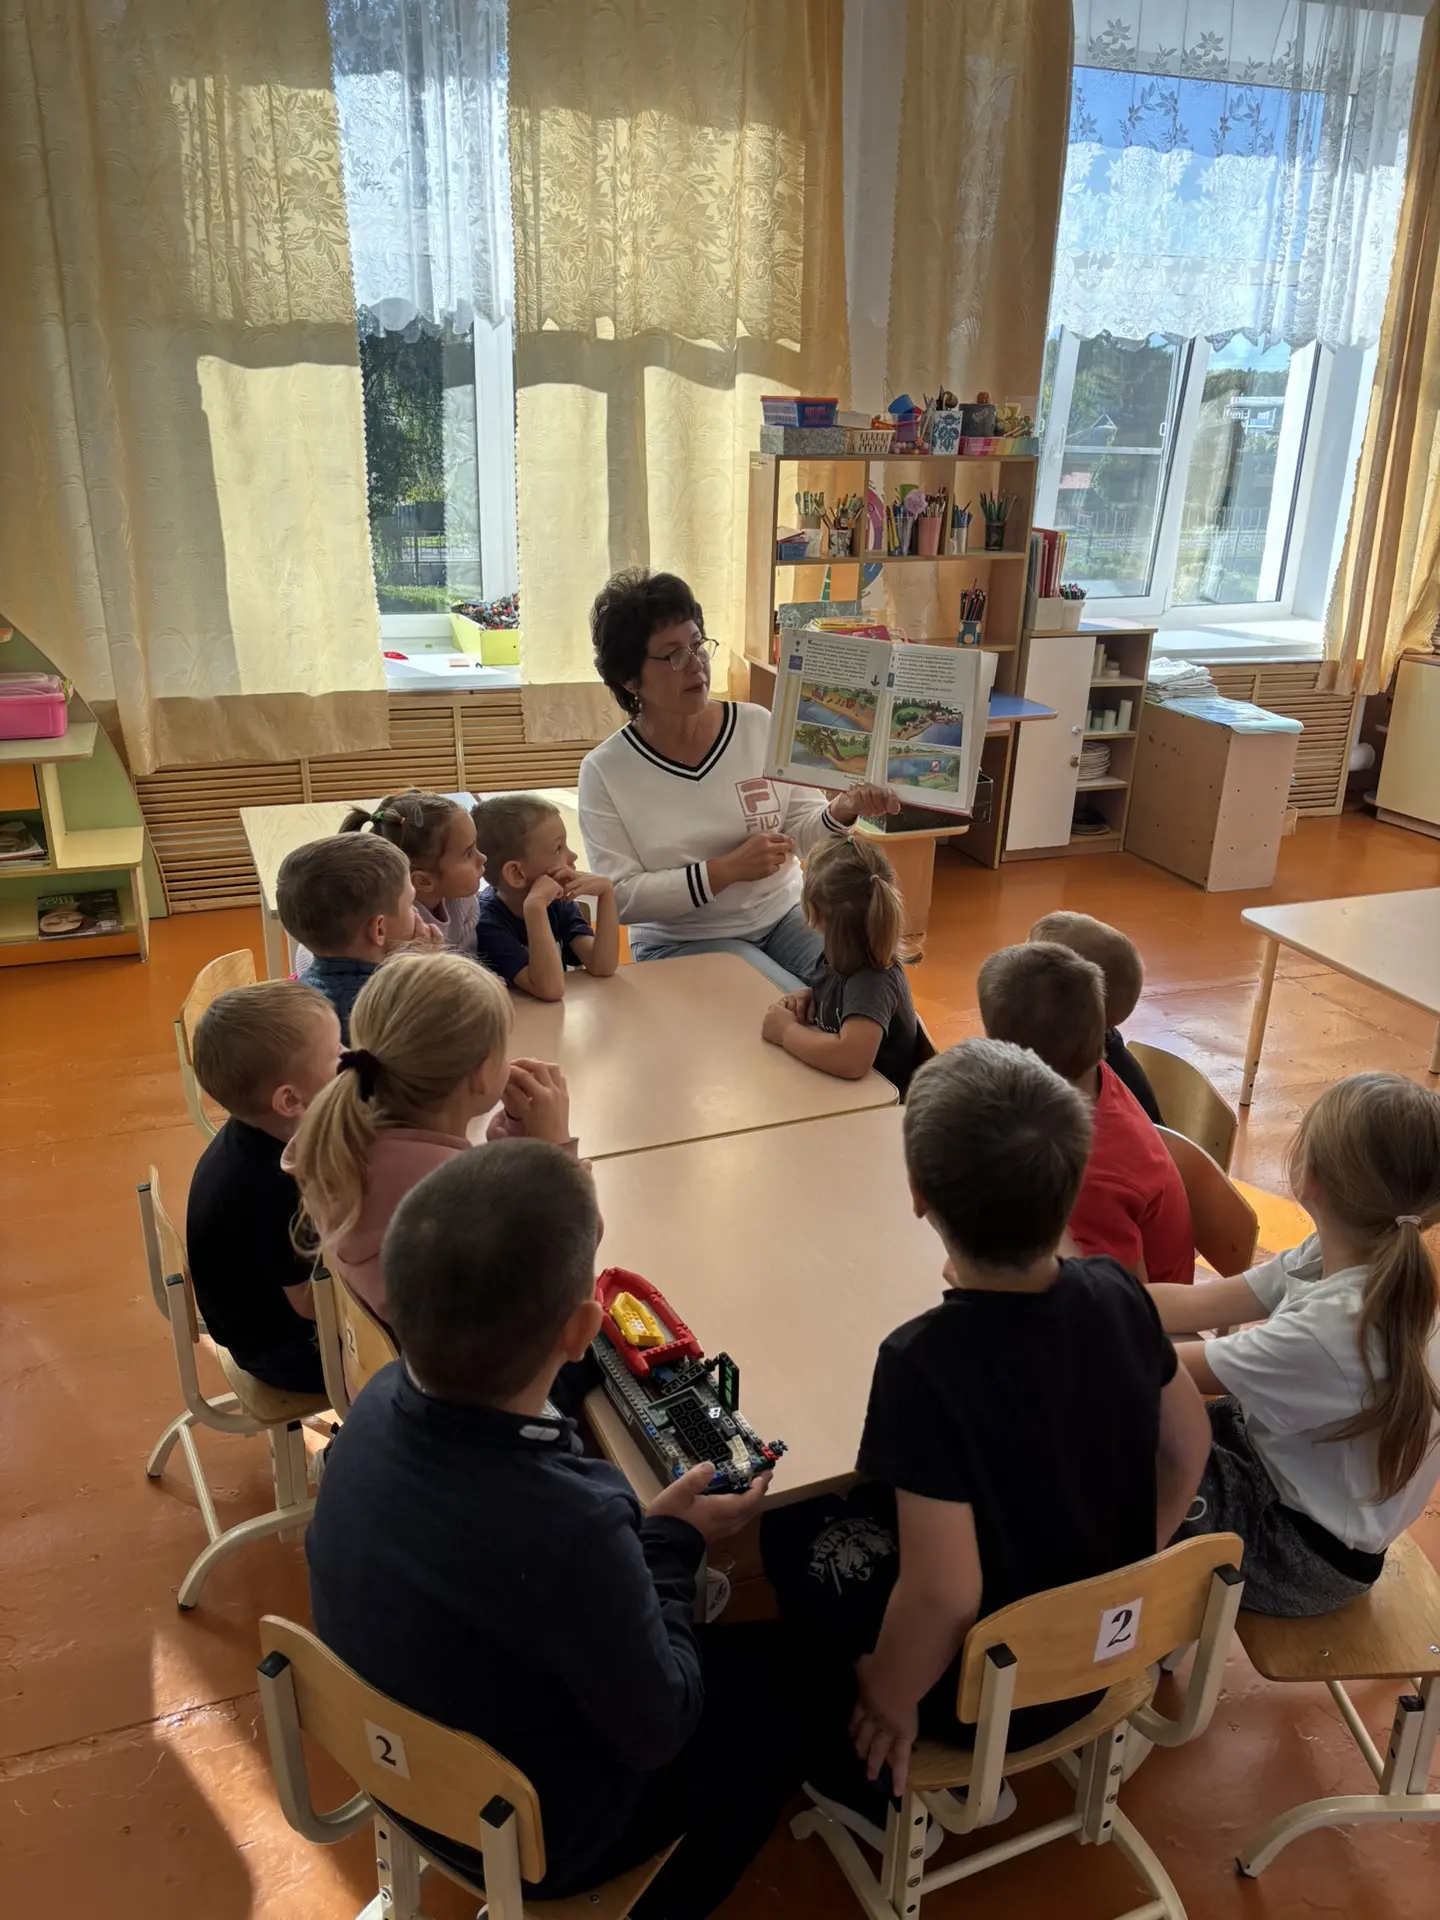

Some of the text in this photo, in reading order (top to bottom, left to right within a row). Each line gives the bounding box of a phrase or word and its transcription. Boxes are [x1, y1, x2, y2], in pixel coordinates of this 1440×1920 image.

[745, 814, 780, 832] FILA
[1107, 1609, 1133, 1648] 2
[376, 1735, 397, 1766] 2
